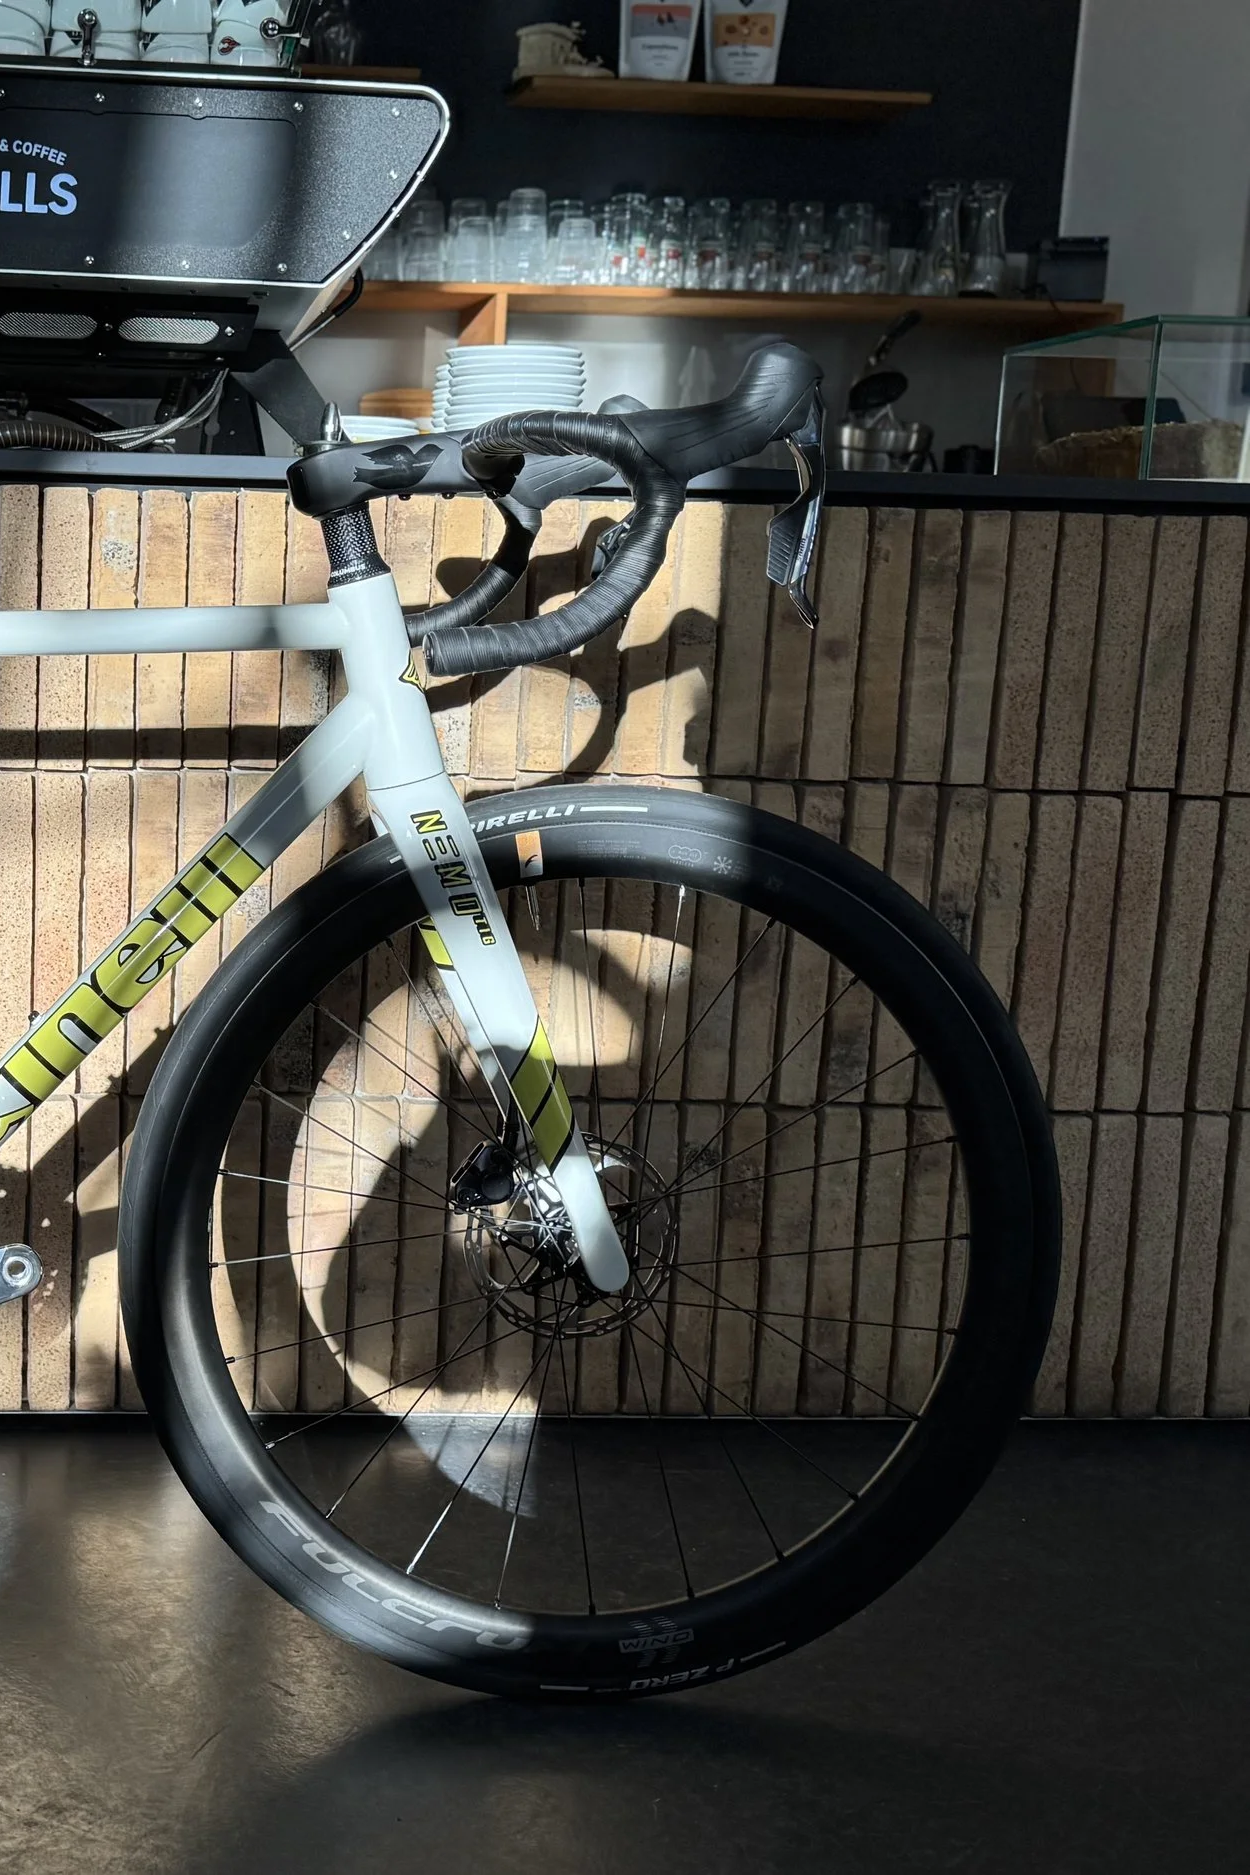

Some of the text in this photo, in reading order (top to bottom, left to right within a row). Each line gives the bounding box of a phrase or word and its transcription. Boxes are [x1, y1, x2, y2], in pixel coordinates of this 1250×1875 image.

[0, 139, 9, 152] &
[12, 140, 68, 166] COFFEE
[472, 913, 497, 946] TIG
[259, 1500, 535, 1651] FULCRU
[629, 1665, 710, 1692] ZERO
